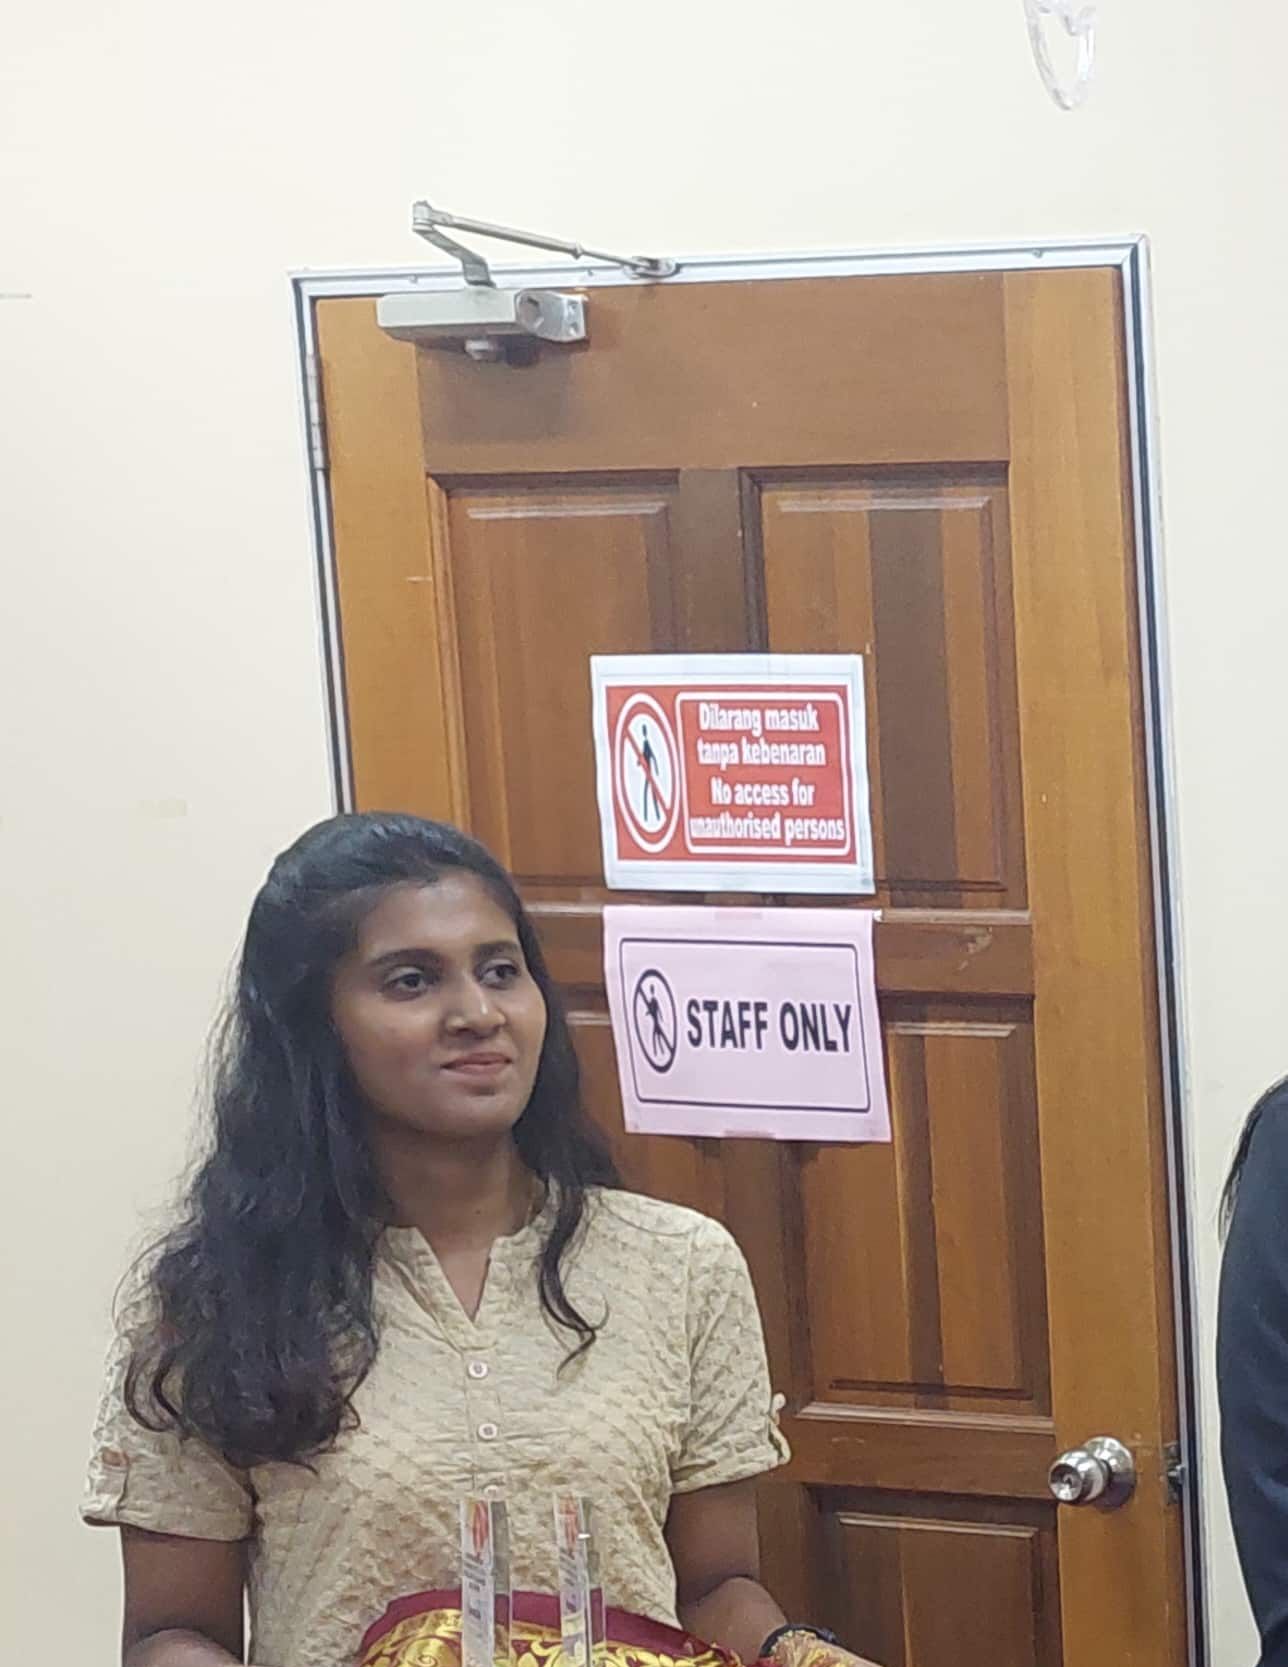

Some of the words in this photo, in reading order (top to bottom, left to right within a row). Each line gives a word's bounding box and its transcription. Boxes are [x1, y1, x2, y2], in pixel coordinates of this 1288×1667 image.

[699, 702, 762, 737] Dilarang
[764, 703, 820, 731] masuk
[697, 737, 739, 771] tanpa
[741, 736, 826, 765] kebenaran
[711, 776, 732, 804] No
[734, 783, 789, 805] access
[792, 777, 815, 805] for
[690, 811, 781, 839] unauthorised
[784, 818, 844, 846] persons
[687, 998, 768, 1049] STAFF
[781, 1003, 852, 1053] ONLY
